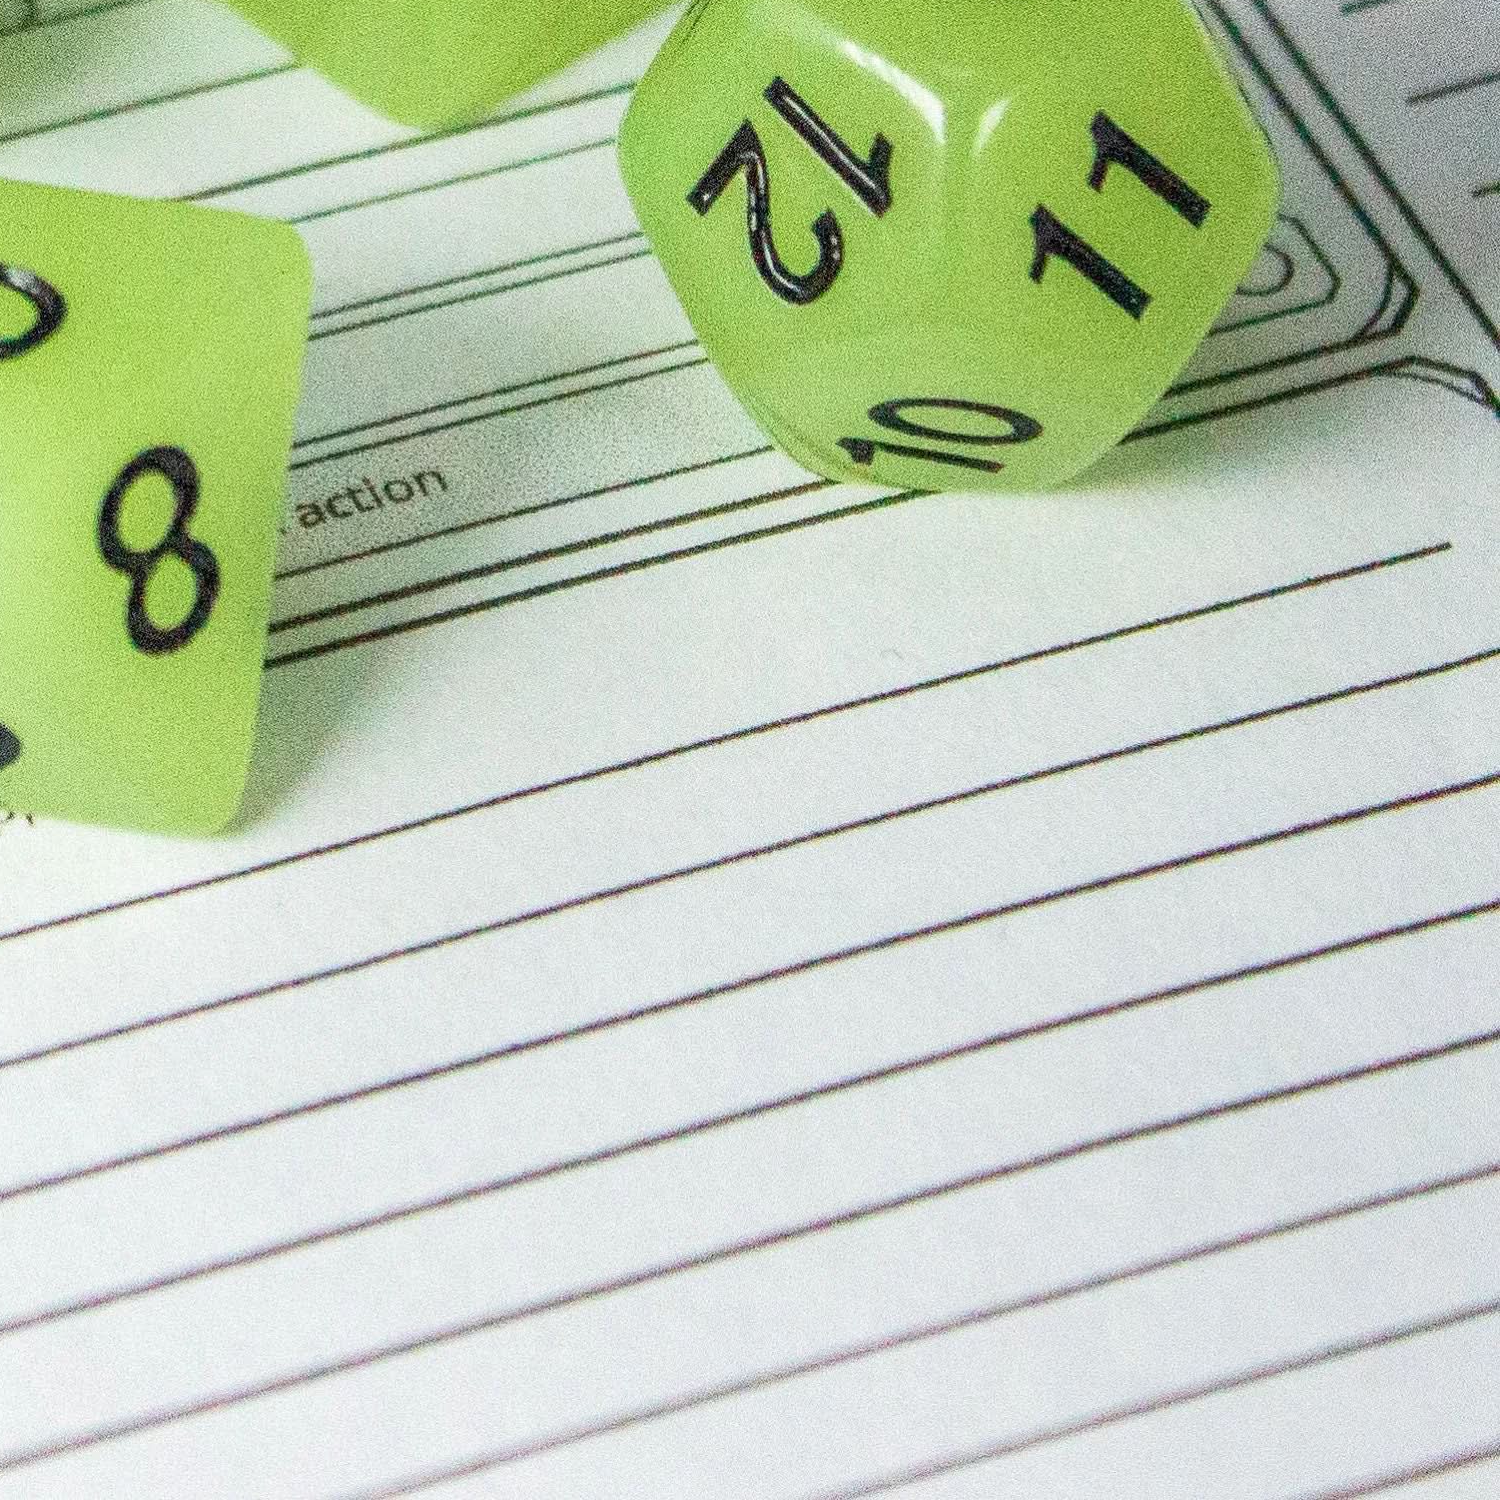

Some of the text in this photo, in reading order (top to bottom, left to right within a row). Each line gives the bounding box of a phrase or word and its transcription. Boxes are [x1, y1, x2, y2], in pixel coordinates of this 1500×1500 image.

[685, 75, 895, 308] 12
[1027, 109, 1214, 323] 11
[293, 467, 450, 530] action
[835, 396, 1045, 475] 10
[95, 443, 224, 658] 8
